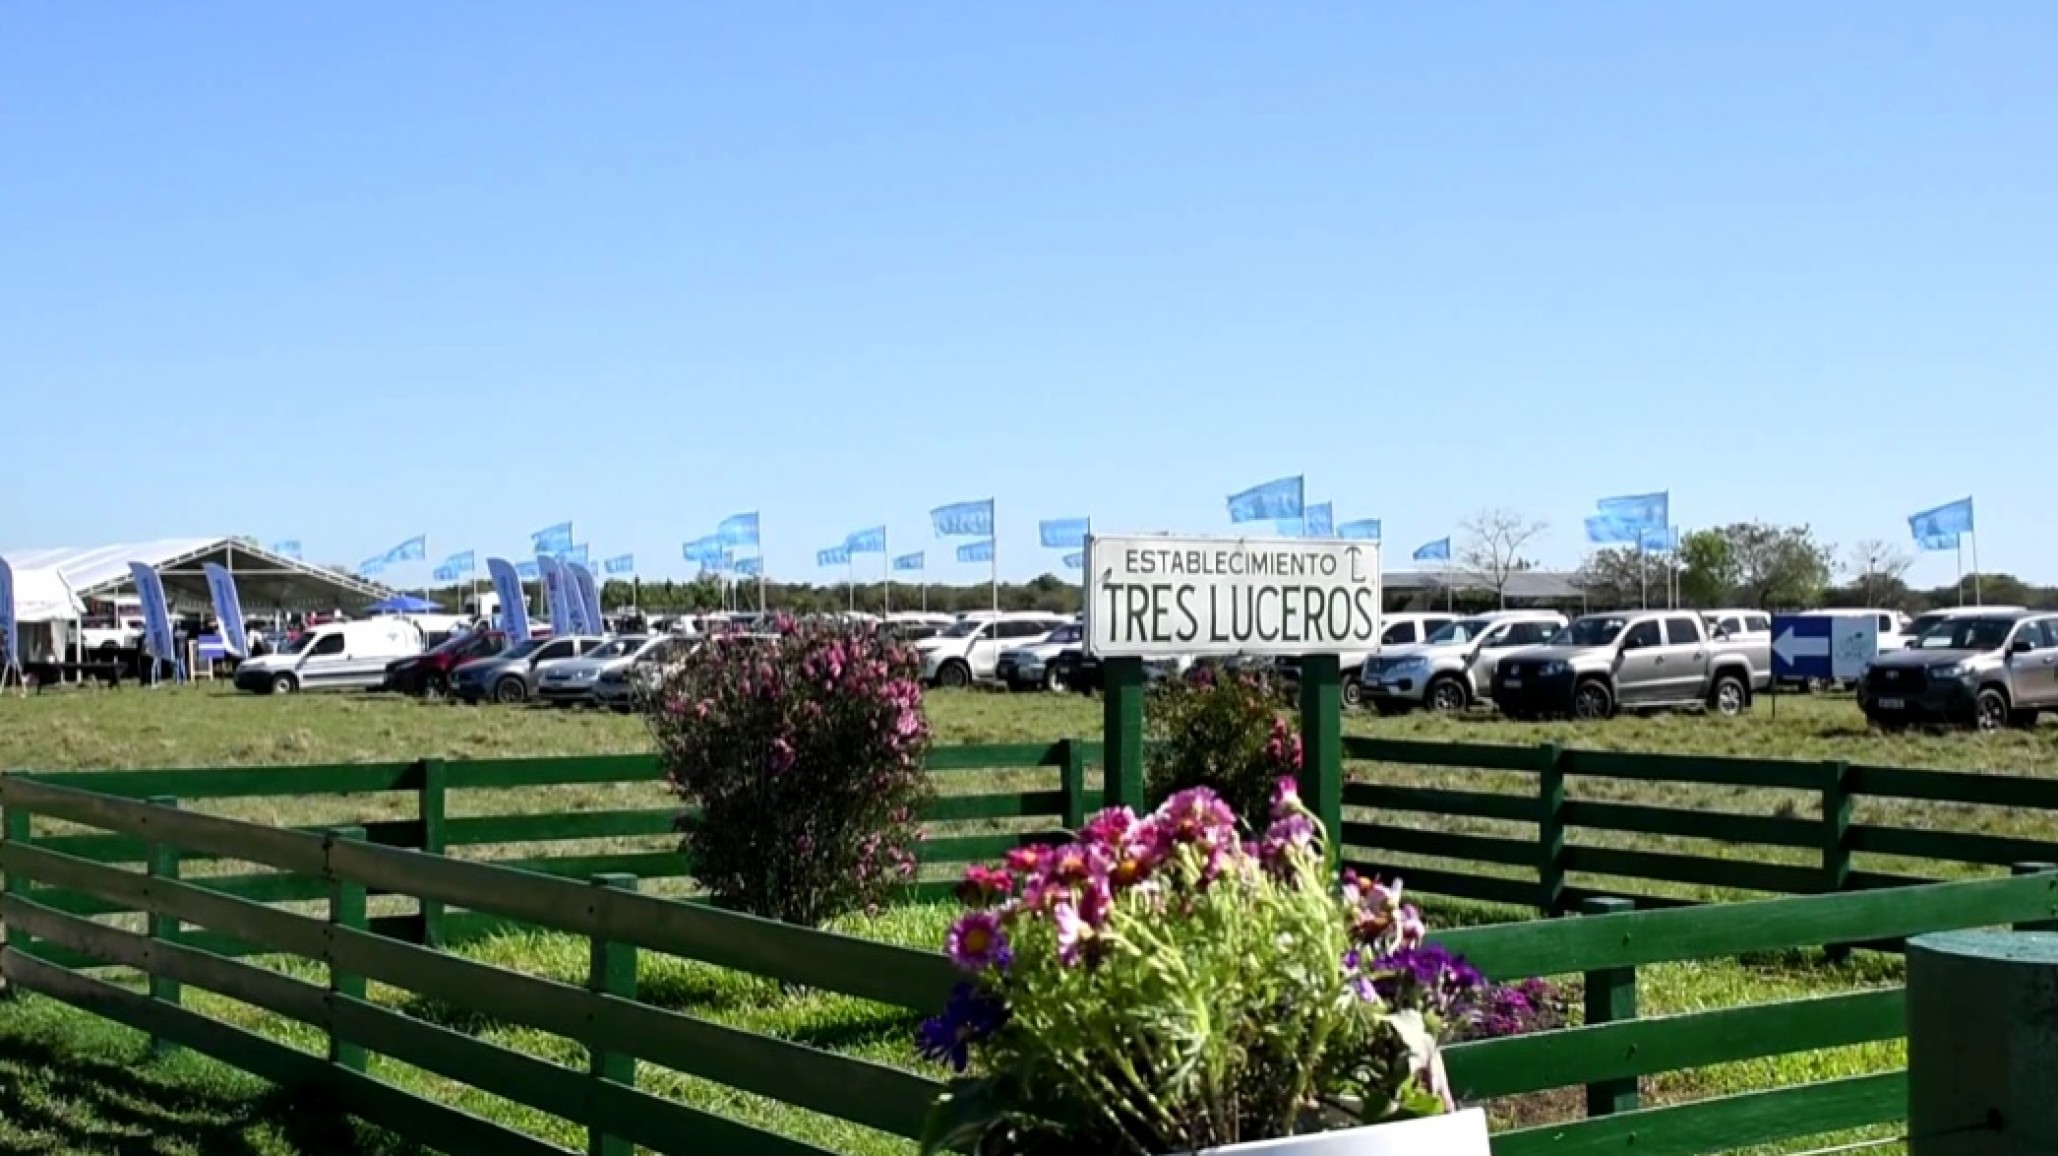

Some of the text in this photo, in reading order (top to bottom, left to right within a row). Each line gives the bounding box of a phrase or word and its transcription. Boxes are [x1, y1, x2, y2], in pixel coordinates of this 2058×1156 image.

[1125, 549, 1337, 576] ESTABLECIMIENTO
[1102, 583, 1373, 643] TRES LUCEROS
